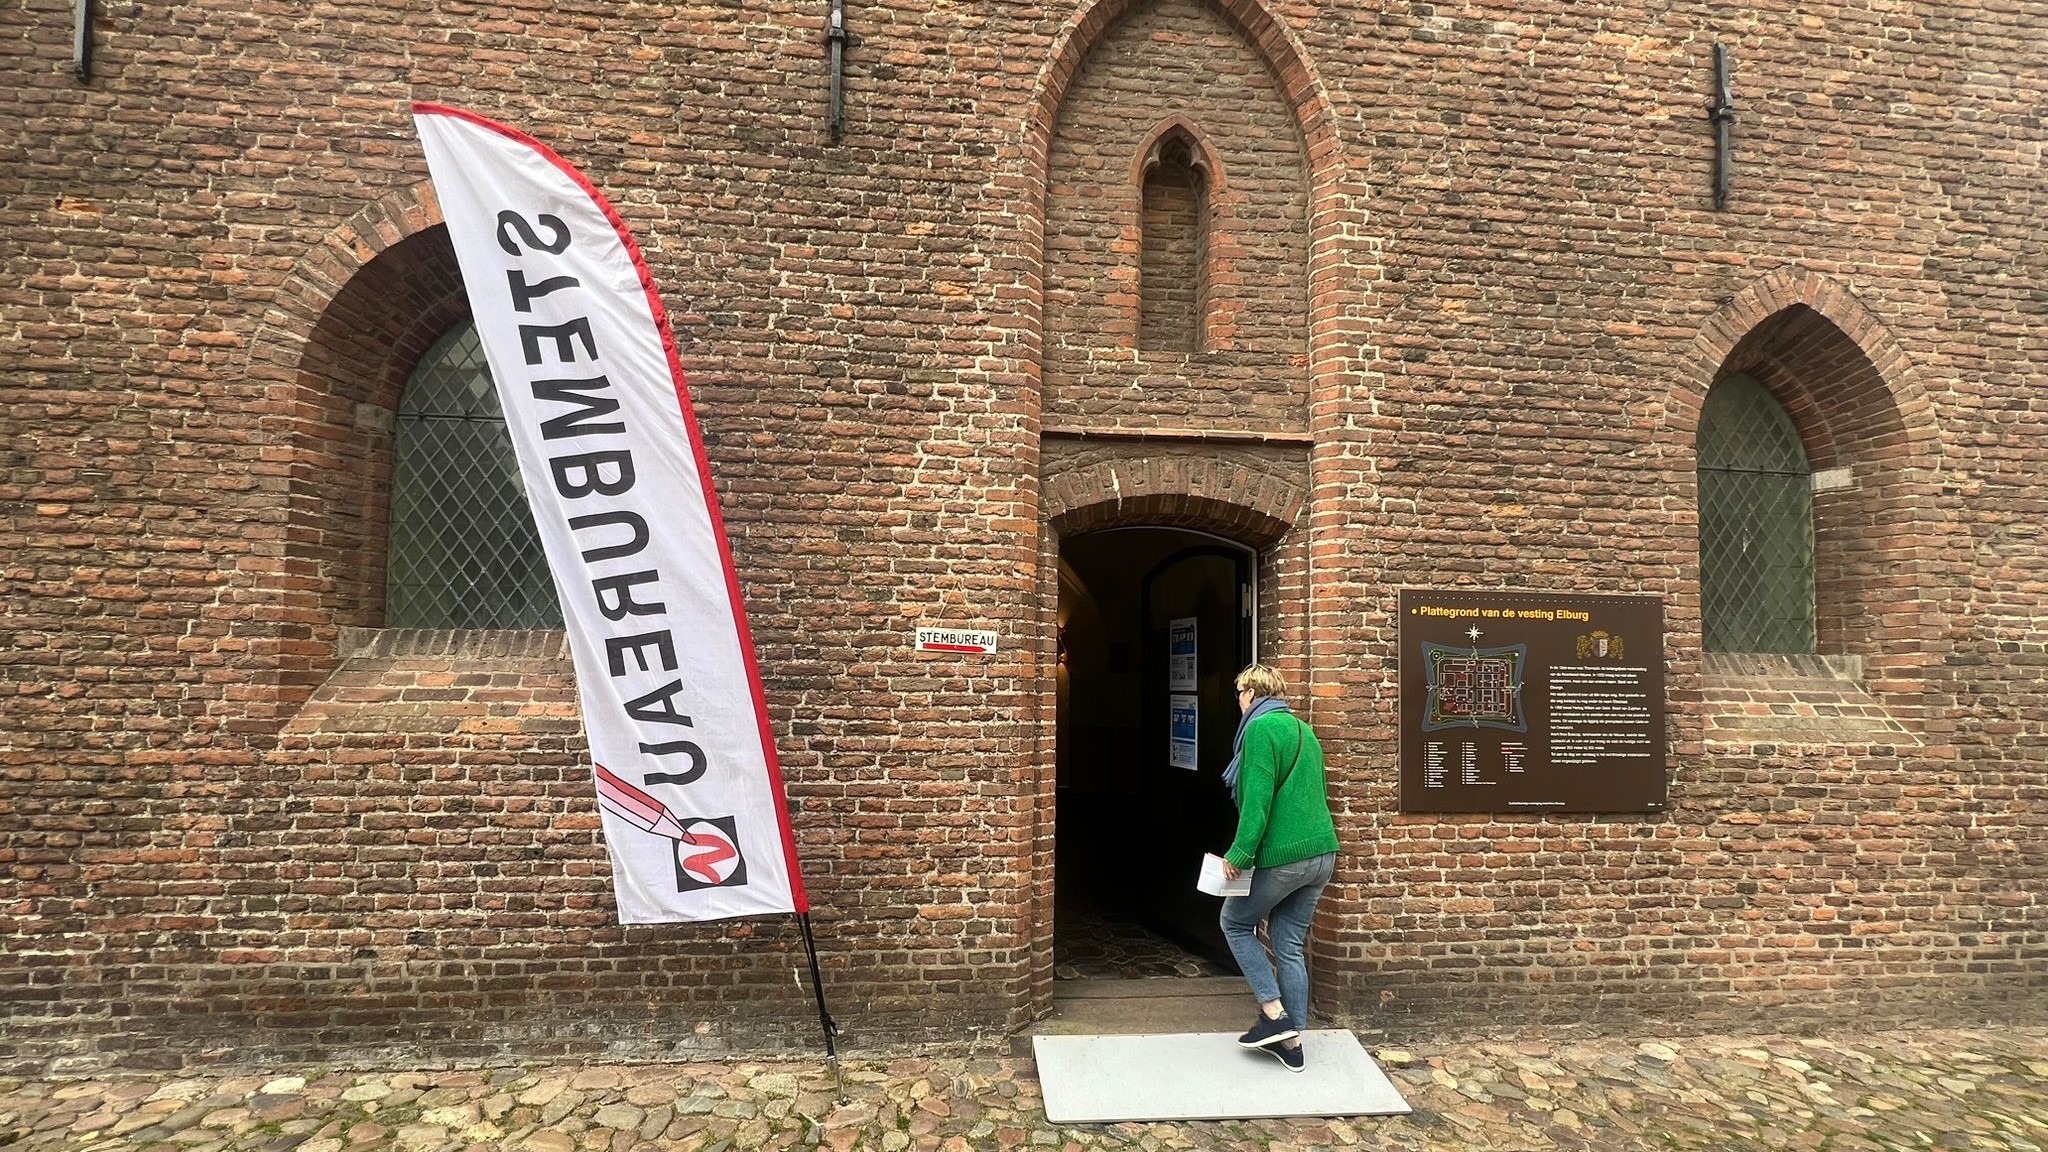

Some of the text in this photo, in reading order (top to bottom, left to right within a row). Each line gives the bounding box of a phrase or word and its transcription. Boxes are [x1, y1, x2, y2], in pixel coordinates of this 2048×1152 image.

[1420, 606, 1589, 621] Plattegrond van de vesting Elburg
[920, 632, 994, 646] STEMBUREAU
